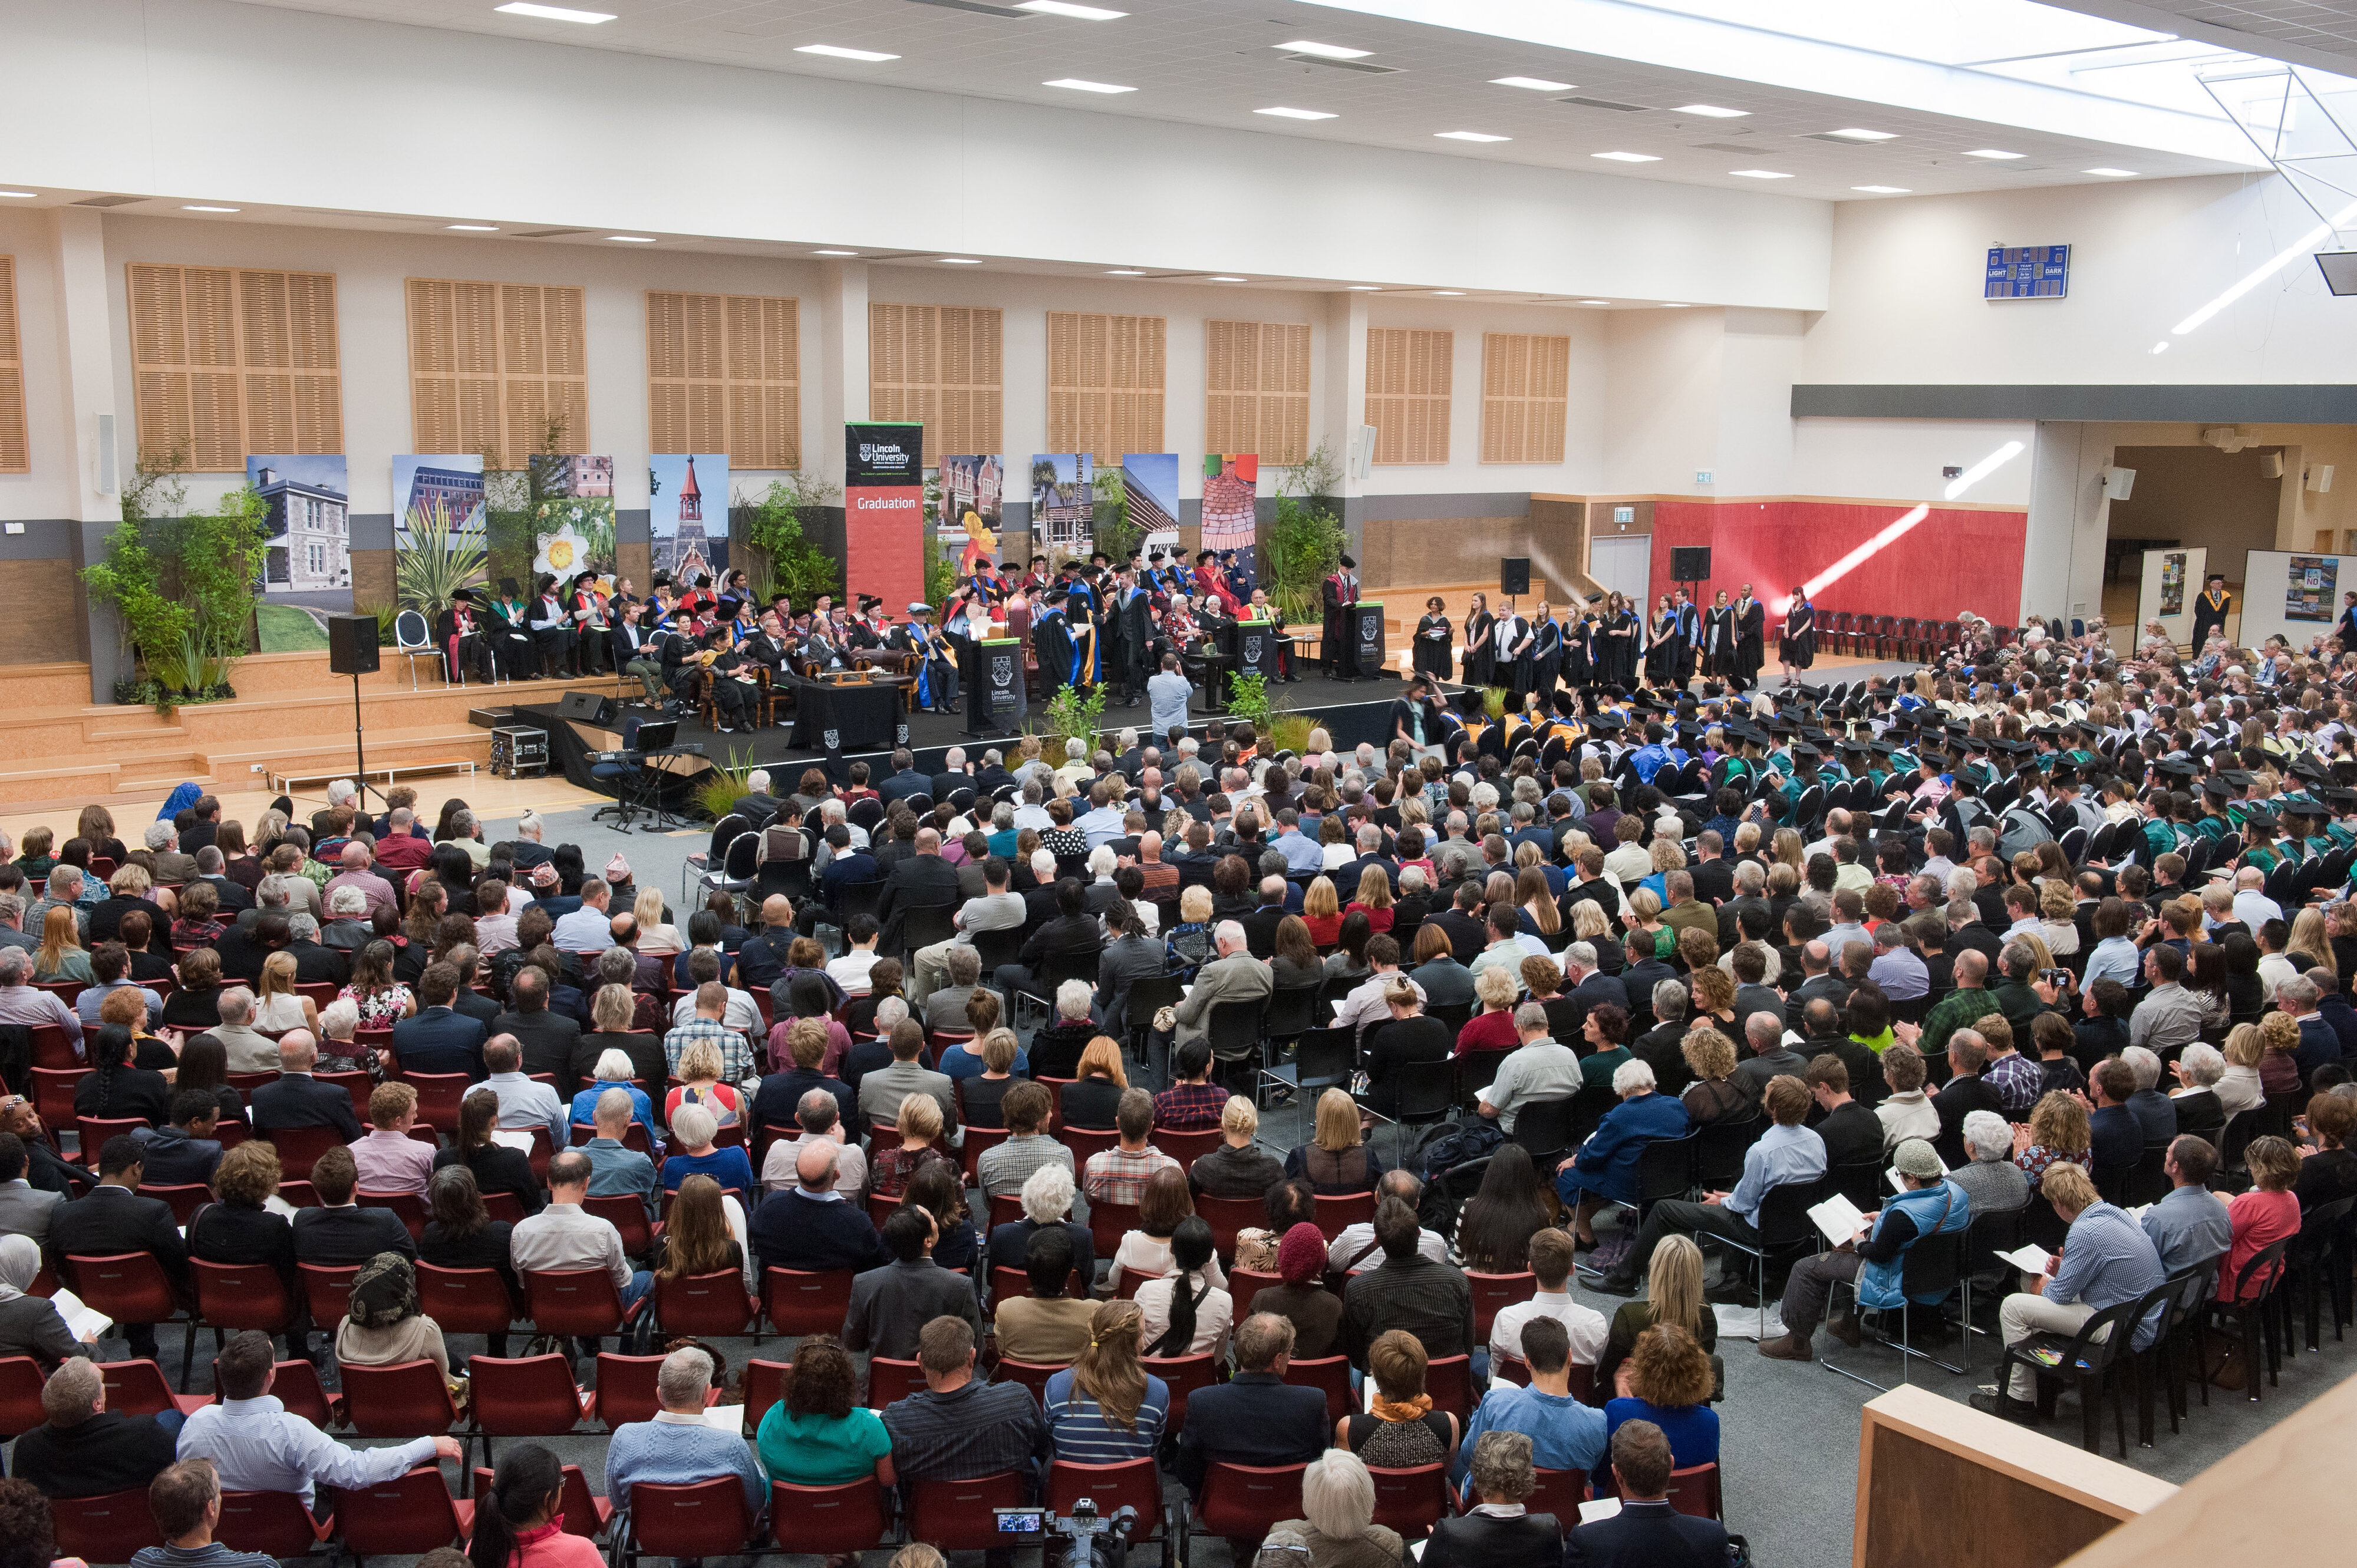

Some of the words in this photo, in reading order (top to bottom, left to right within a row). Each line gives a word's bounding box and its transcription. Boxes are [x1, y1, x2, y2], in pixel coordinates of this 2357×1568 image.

[872, 444, 901, 453] Lincoln
[872, 453, 909, 464] University
[858, 497, 915, 510] Graduation
